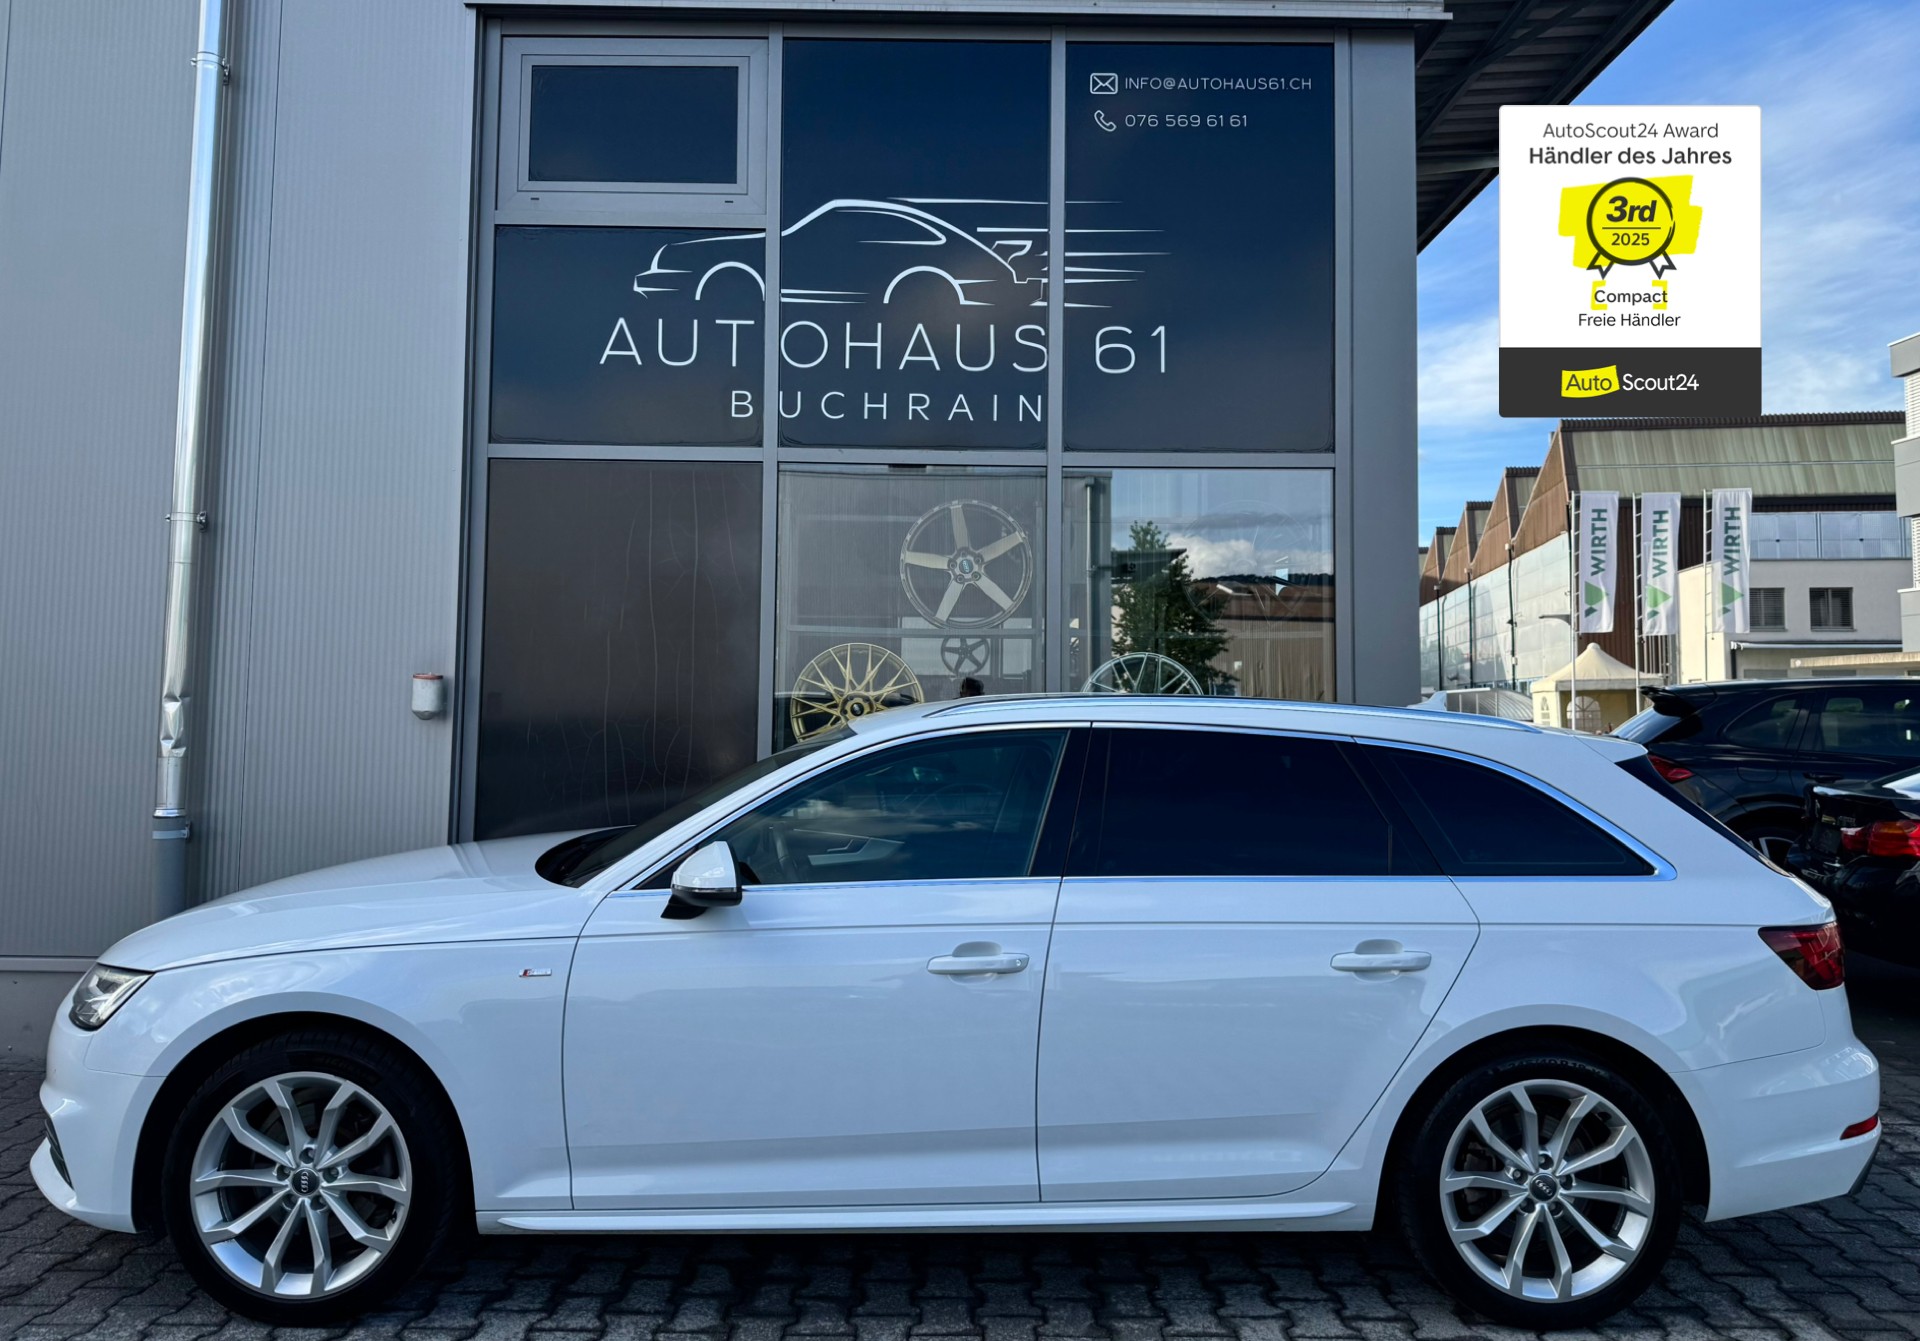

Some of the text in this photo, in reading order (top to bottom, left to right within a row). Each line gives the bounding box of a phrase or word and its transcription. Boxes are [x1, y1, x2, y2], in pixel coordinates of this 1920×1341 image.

[1125, 77, 1312, 91] INFO@AUTOHAUS61.CH
[1124, 114, 1247, 127] 076 569 61 61
[599, 317, 1167, 374] AUTOHAUS 61
[730, 390, 1044, 422] BUCHRAIN
[1590, 508, 1608, 577] WIRTH
[1652, 509, 1669, 579] WIRTH
[1723, 507, 1741, 576] WIRTH
